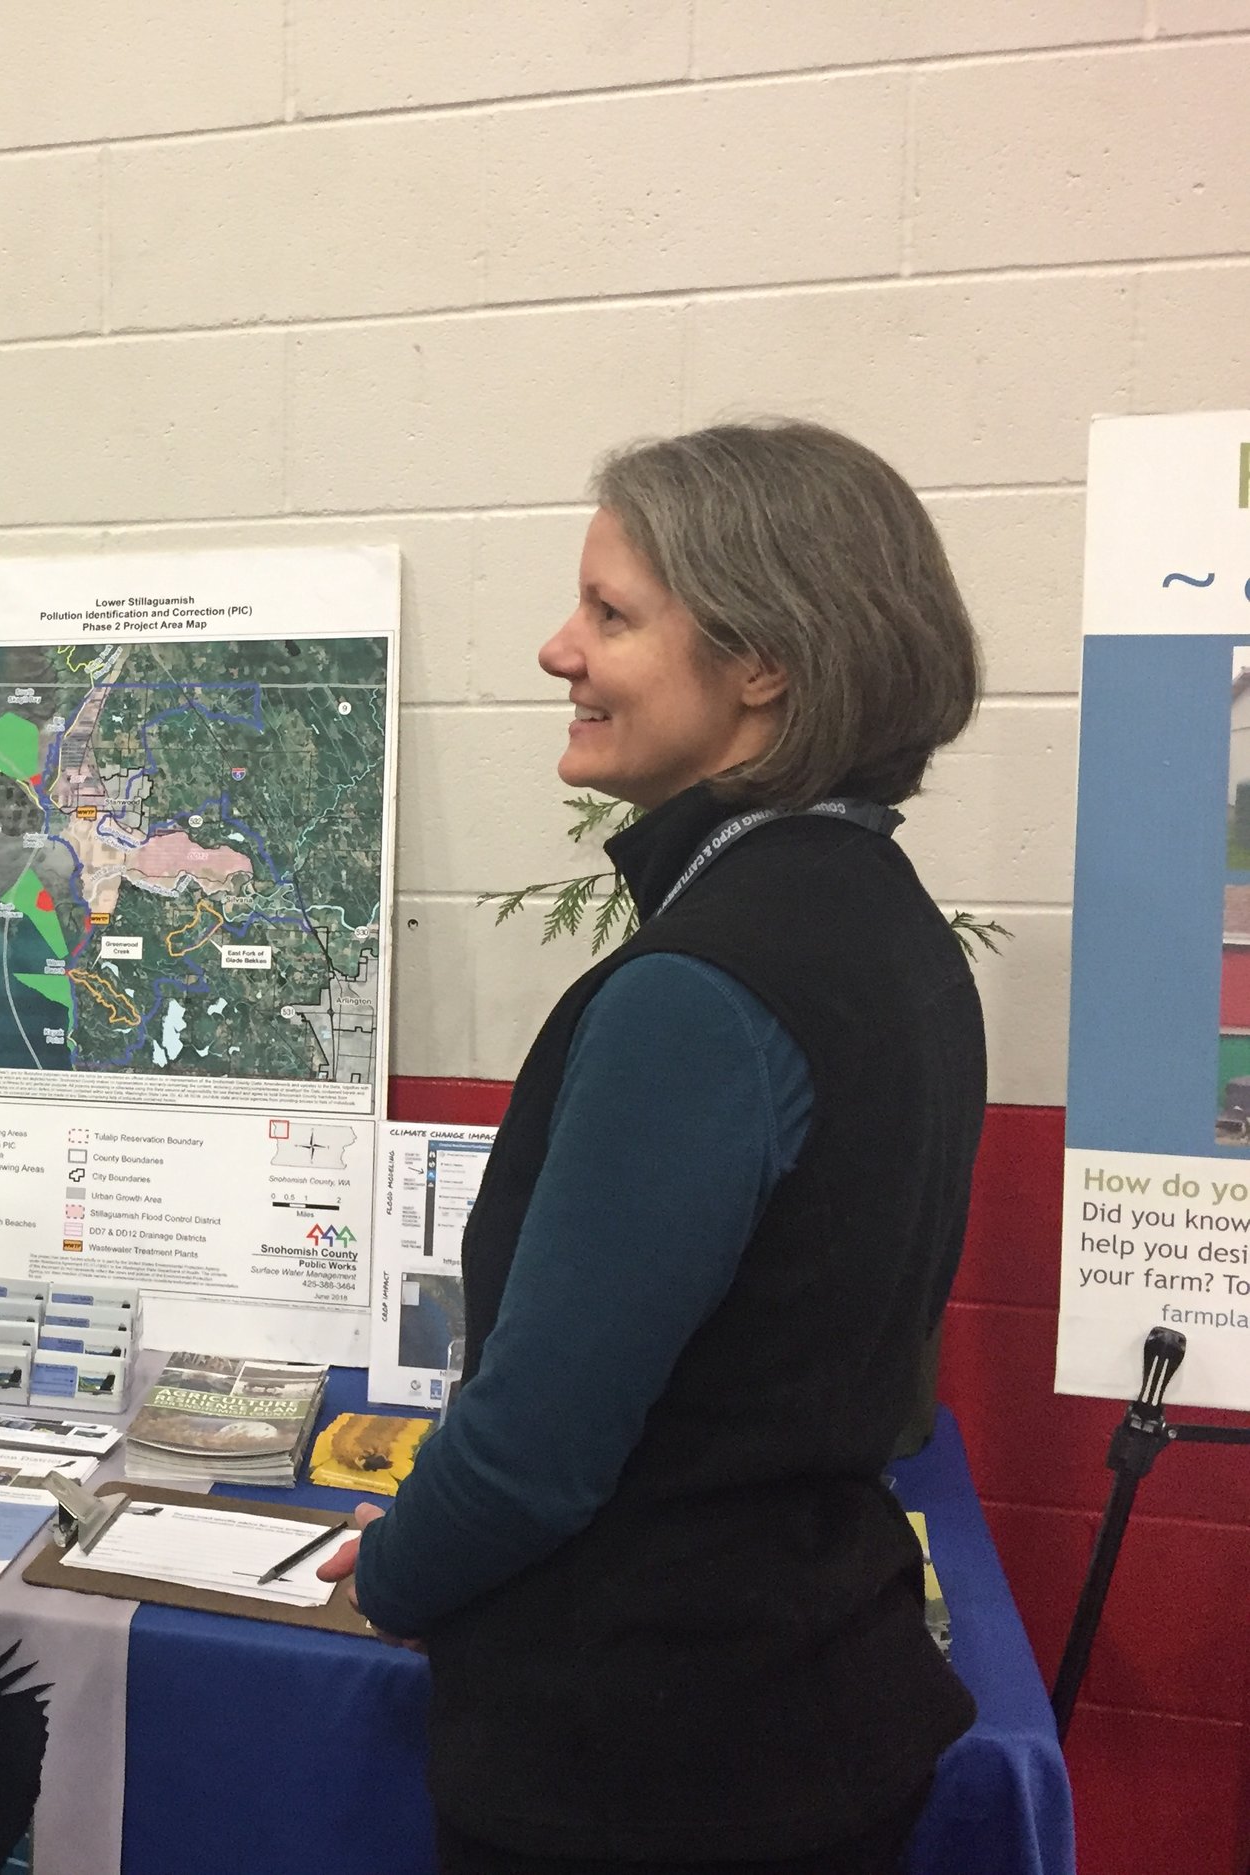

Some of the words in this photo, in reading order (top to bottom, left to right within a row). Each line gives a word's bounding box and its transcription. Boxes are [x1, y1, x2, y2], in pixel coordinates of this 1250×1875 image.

[95, 598, 125, 607] Lower
[128, 596, 195, 607] Stillaguamish
[40, 611, 83, 621] Pollution
[86, 609, 148, 620] Identification
[151, 609, 169, 618] and
[172, 607, 225, 618] Correction
[228, 605, 253, 617] (PIC)
[82, 622, 112, 632] Phase
[115, 622, 121, 631] 2
[123, 621, 158, 632] Project
[160, 620, 183, 630] Area
[186, 620, 207, 630] Map
[808, 802, 846, 814] COU
[712, 821, 742, 849] EXPO
[702, 845, 713, 857] &
[336, 997, 372, 1006] Arlington
[7, 1129, 28, 1137] Areas
[94, 1132, 119, 1142] Tulalip
[120, 1134, 165, 1144] Reservation
[167, 1136, 204, 1147] Boundary
[390, 1129, 427, 1138] CLIMATE
[430, 1131, 465, 1139] CHANGE
[93, 1154, 119, 1163] County
[121, 1155, 164, 1165] Boundaries
[21, 1164, 45, 1173] Areas
[387, 1150, 395, 1189] MODELING
[92, 1172, 107, 1182] City
[108, 1174, 151, 1183] Boundaries
[269, 1175, 307, 1185] Snohomish
[309, 1178, 336, 1187] County,
[1084, 1168, 1151, 1195] How
[1162, 1173, 1200, 1198] do
[1212, 1181, 1249, 1206] yo
[91, 1192, 113, 1200] Urban
[116, 1193, 143, 1202] Growth
[144, 1195, 162, 1204] Area
[90, 1209, 139, 1220] Stillaguamish
[141, 1212, 163, 1222] Flood
[164, 1214, 192, 1224] Control
[194, 1215, 221, 1225] District
[296, 1210, 314, 1219] Miles
[1082, 1201, 1122, 1224] Did
[1131, 1209, 1175, 1230] you
[1186, 1209, 1250, 1233] know
[5, 1219, 37, 1228] Beaches
[89, 1228, 106, 1236] DD7
[115, 1229, 137, 1238] DD12
[139, 1231, 174, 1242] Drainage
[176, 1232, 207, 1243] Districts
[89, 1244, 133, 1254] Wastewater
[134, 1247, 173, 1257] Treatment
[174, 1249, 199, 1258] Plants
[261, 1244, 319, 1257] Snohomish
[321, 1249, 358, 1262] County
[1081, 1232, 1135, 1260] help
[1144, 1241, 1188, 1262] you
[1198, 1242, 1249, 1264] desi
[299, 1259, 326, 1269] Public
[329, 1261, 357, 1271] Works
[250, 1265, 279, 1276] Surface
[281, 1267, 304, 1277] Water
[306, 1269, 356, 1281] Management
[1079, 1267, 1135, 1288] your
[1144, 1268, 1214, 1293] farm?
[1223, 1274, 1250, 1296] To
[314, 1292, 330, 1300] June
[1162, 1304, 1250, 1329] farmpla
[154, 1395, 248, 1411] RESILIENCE
[158, 1388, 299, 1408] AGRICULTURE
[178, 1402, 247, 1416] SNOHOMISH
[20, 1455, 62, 1465] District
